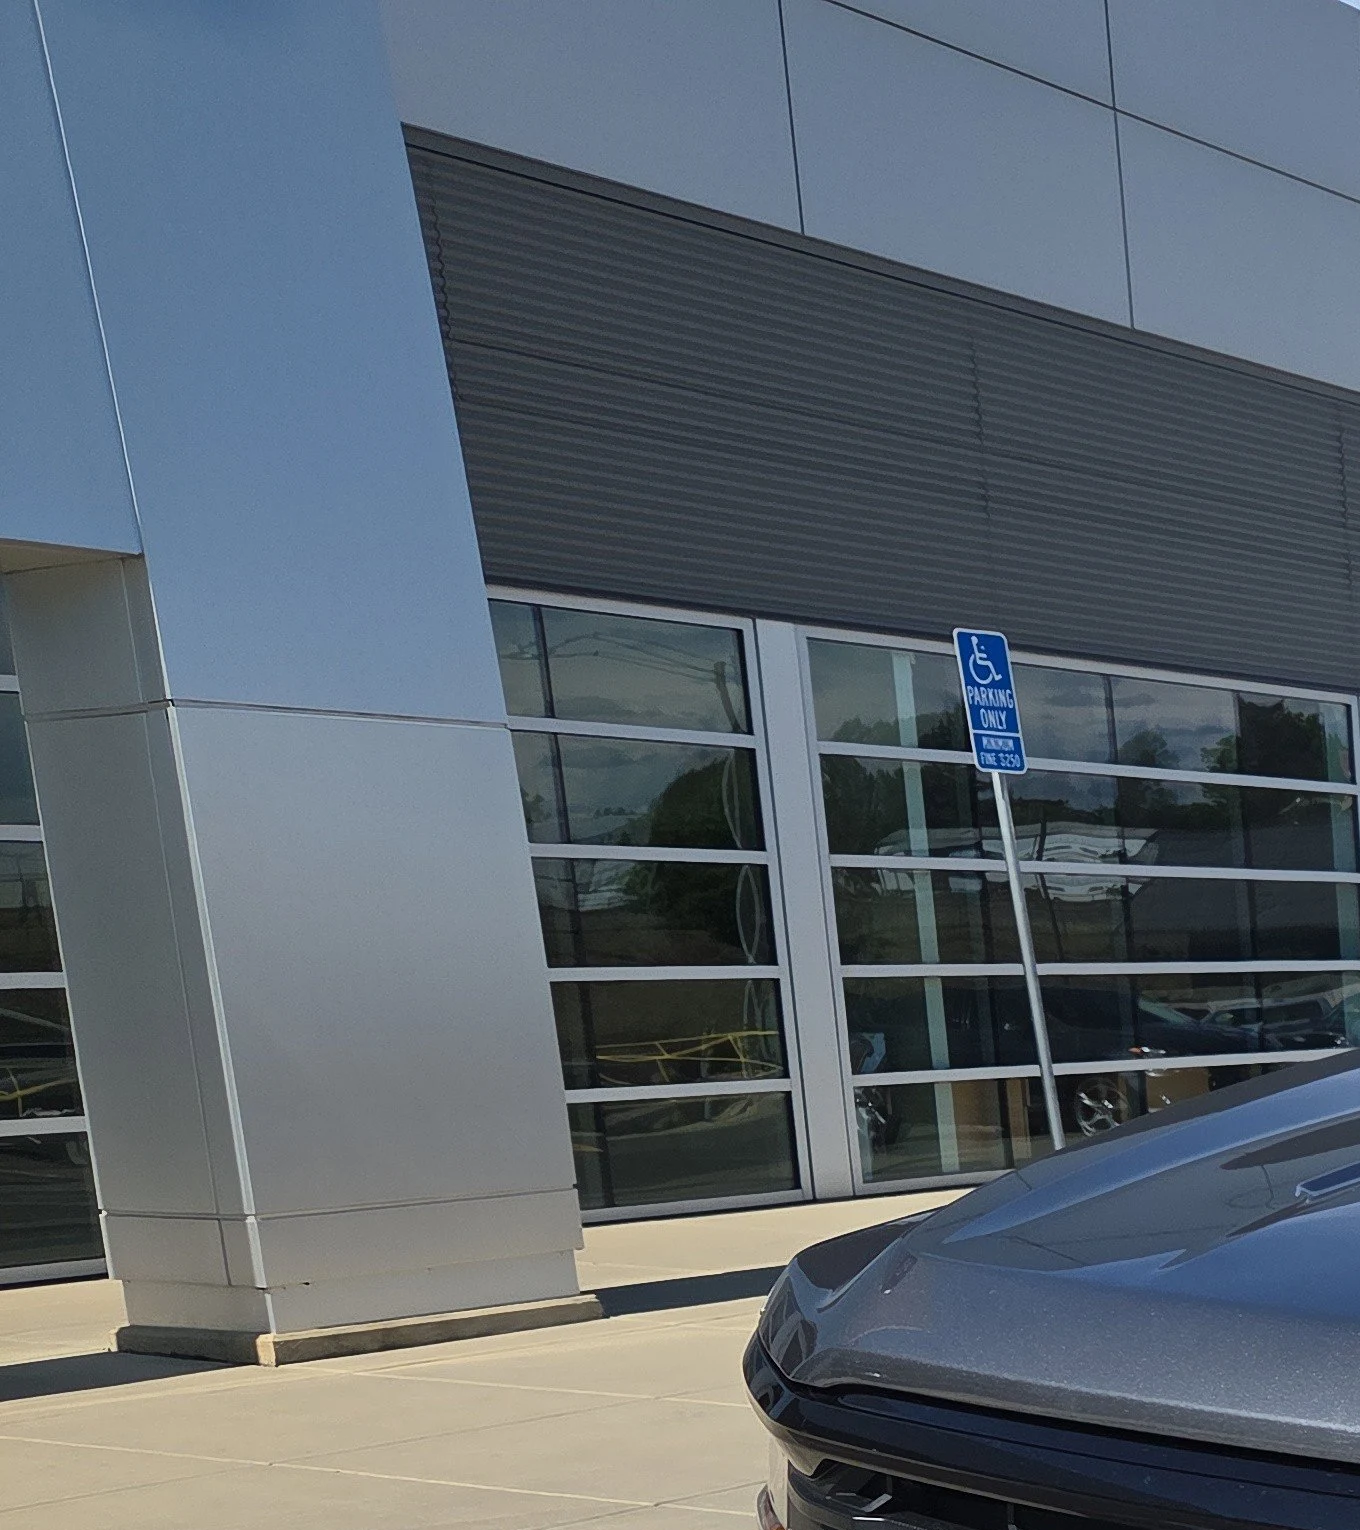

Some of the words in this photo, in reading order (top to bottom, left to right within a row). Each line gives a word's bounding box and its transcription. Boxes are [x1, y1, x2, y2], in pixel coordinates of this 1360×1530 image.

[966, 685, 1015, 709] PARKING
[979, 708, 1007, 730] ONLY
[980, 751, 998, 766] FINE
[998, 752, 1021, 768] $250
